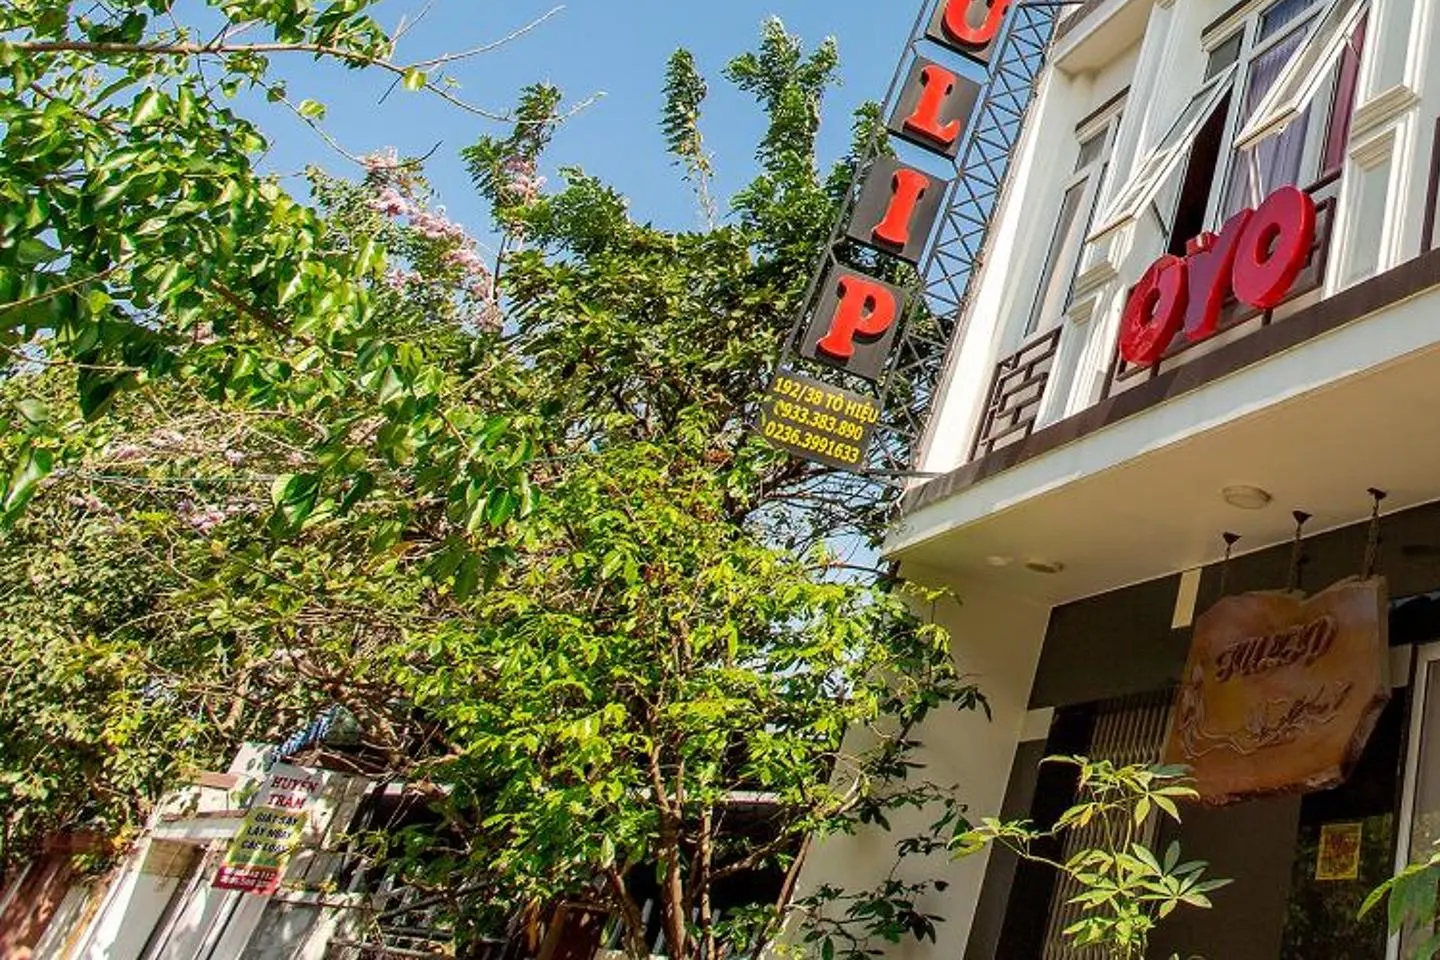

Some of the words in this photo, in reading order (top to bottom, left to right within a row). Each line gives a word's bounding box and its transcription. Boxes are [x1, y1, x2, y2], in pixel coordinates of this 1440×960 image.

[1119, 183, 1316, 366] OYO
[773, 377, 824, 406] 192/38
[764, 421, 860, 464] 0236.3991633
